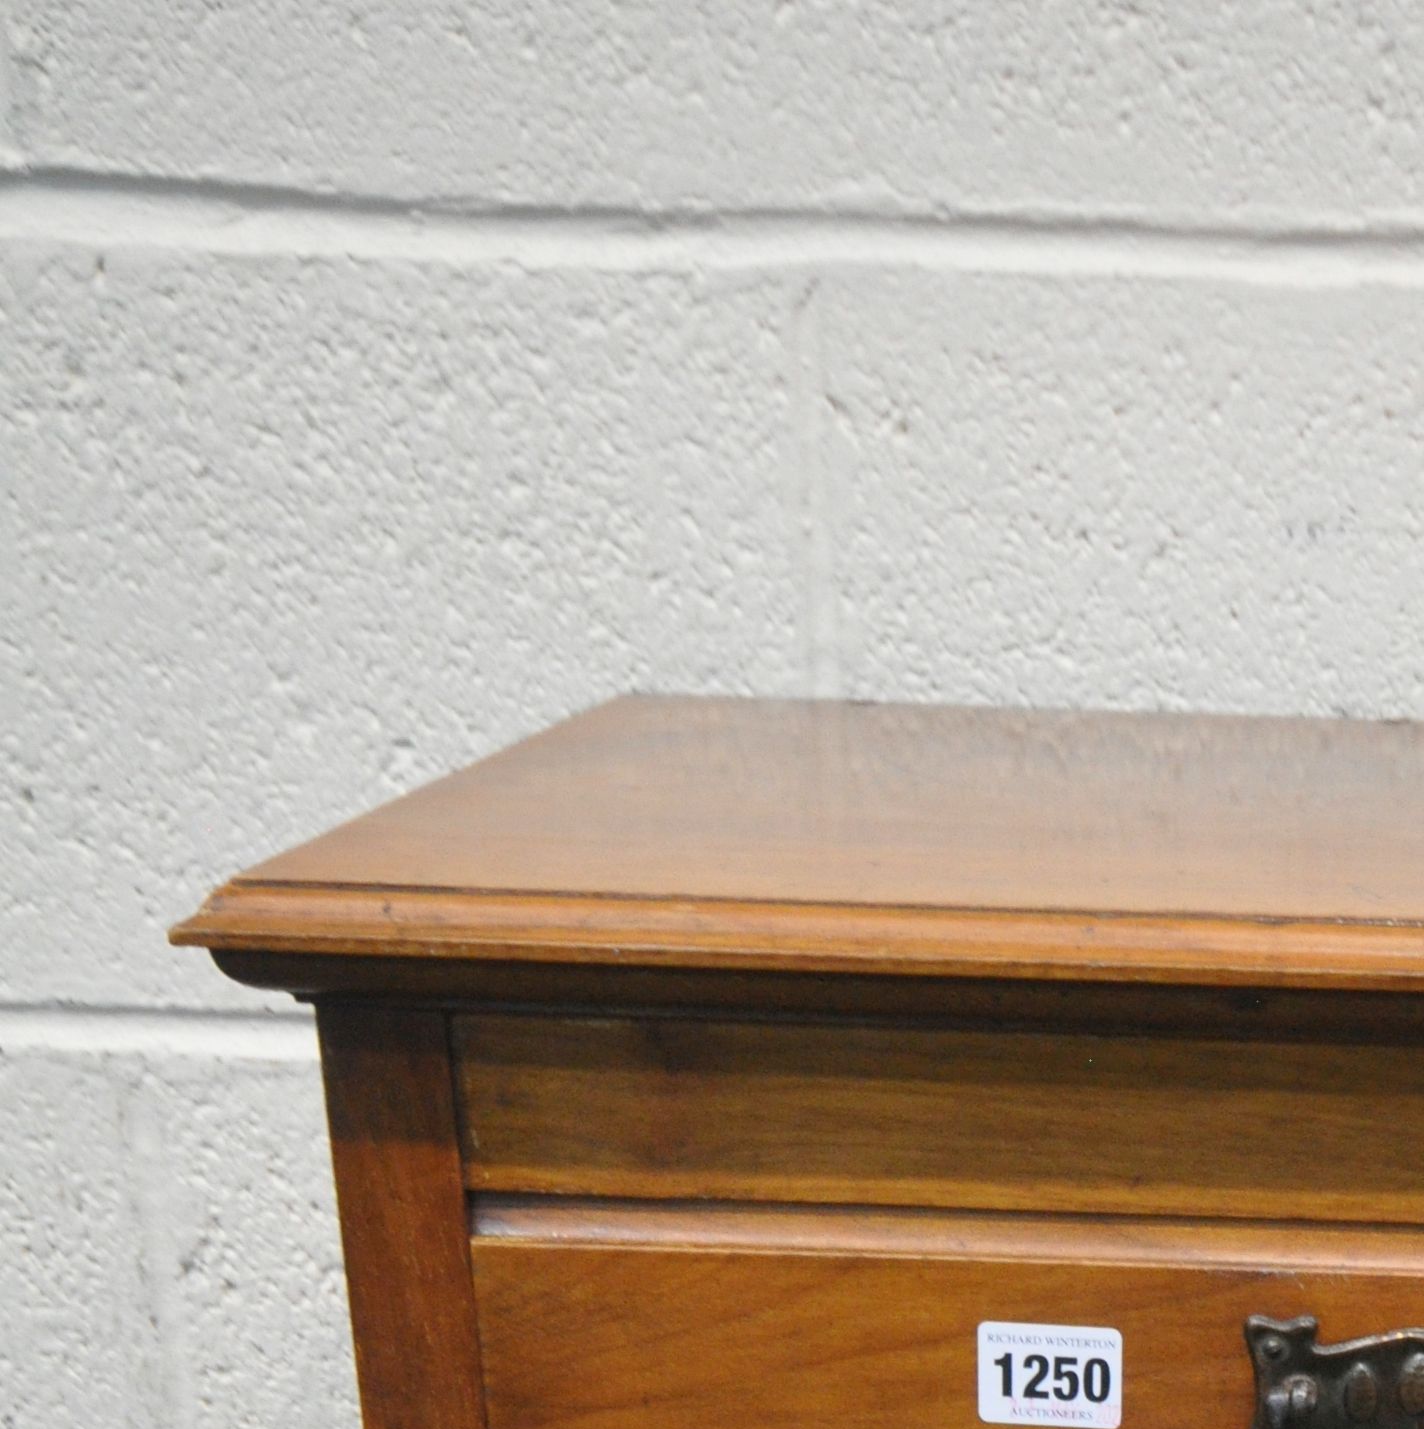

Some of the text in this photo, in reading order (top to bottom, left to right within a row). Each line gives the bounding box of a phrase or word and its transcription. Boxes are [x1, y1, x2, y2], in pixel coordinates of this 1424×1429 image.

[987, 1332, 1116, 1350] RICHARD WINTERTON
[993, 1352, 1111, 1404] 1250
[1010, 1407, 1093, 1421] AUCTIONEERS
